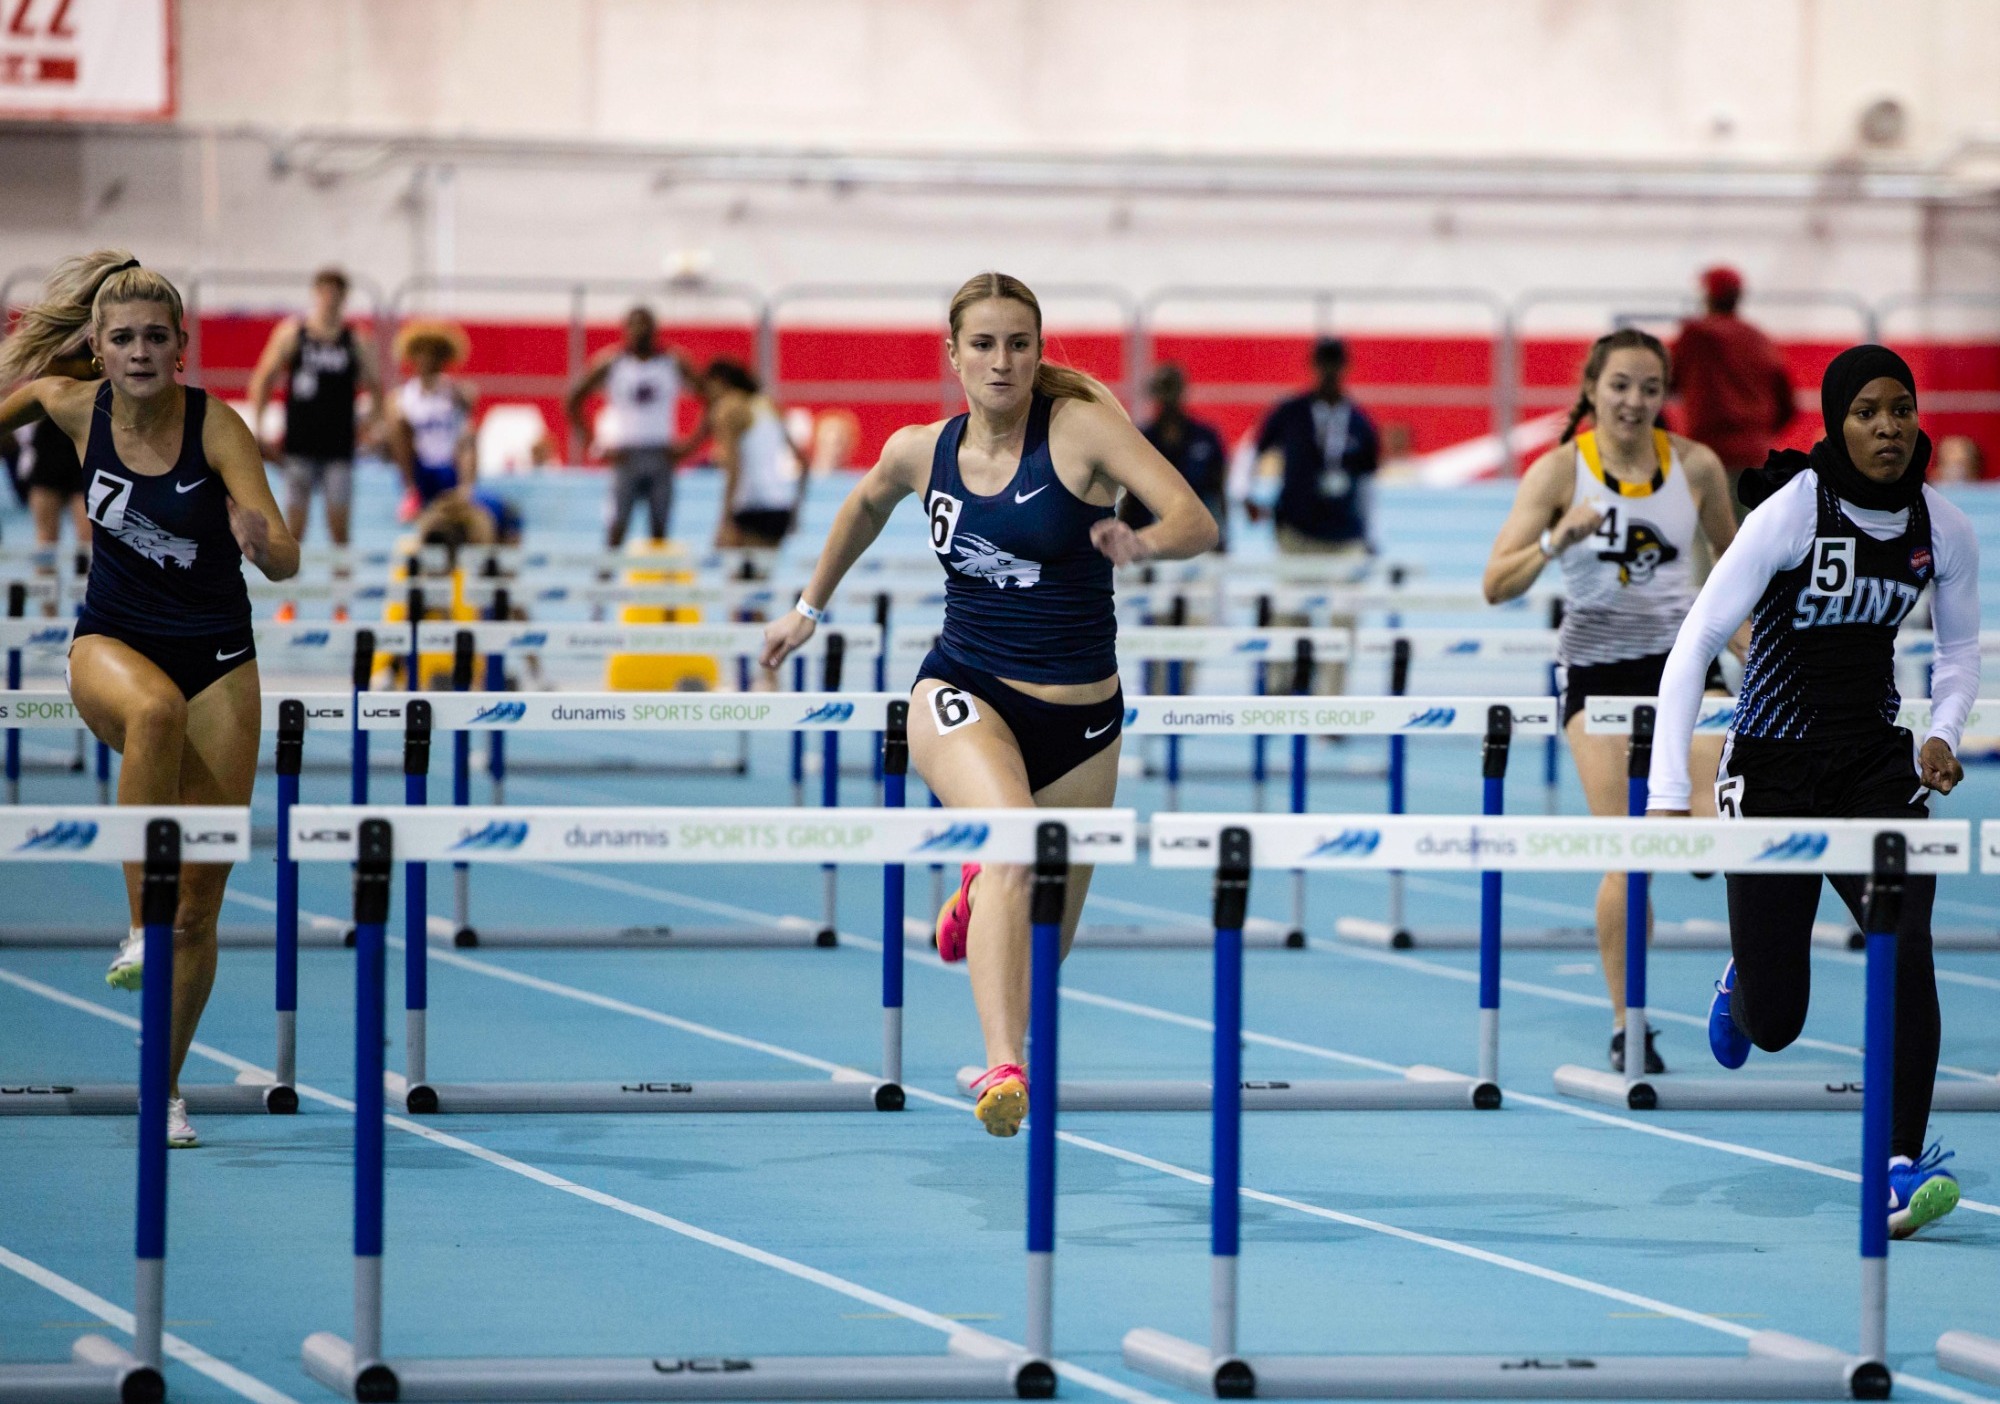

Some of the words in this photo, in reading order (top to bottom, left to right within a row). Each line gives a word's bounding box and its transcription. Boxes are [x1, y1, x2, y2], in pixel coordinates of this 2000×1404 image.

[95, 474, 126, 522] 7
[931, 496, 954, 548] 6
[1596, 506, 1620, 546] 4
[1816, 541, 1848, 592] 5
[1792, 576, 1920, 631] SAINT
[15, 701, 81, 720] SPORT
[306, 708, 345, 718] UCS
[363, 708, 401, 718] UCS
[551, 704, 626, 721] dunamis
[632, 703, 703, 721] SPORTS
[709, 703, 771, 721] GROUP
[934, 687, 970, 727] 6
[1162, 709, 1235, 726] dunamis
[1240, 709, 1310, 727] SPORTS
[1315, 709, 1376, 727] GROUP
[1512, 714, 1549, 723] UCS
[1591, 713, 1628, 723] UCS
[183, 831, 239, 845] UCS
[298, 830, 351, 843] UCS
[563, 824, 670, 848] dunamis
[678, 823, 780, 849] SPORTS
[786, 824, 875, 848] GROUP
[1414, 832, 1518, 856] dunamis
[1525, 833, 1624, 858] SPORTS
[1629, 834, 1716, 859] GROUP
[1825, 1081, 1865, 1093] UC
